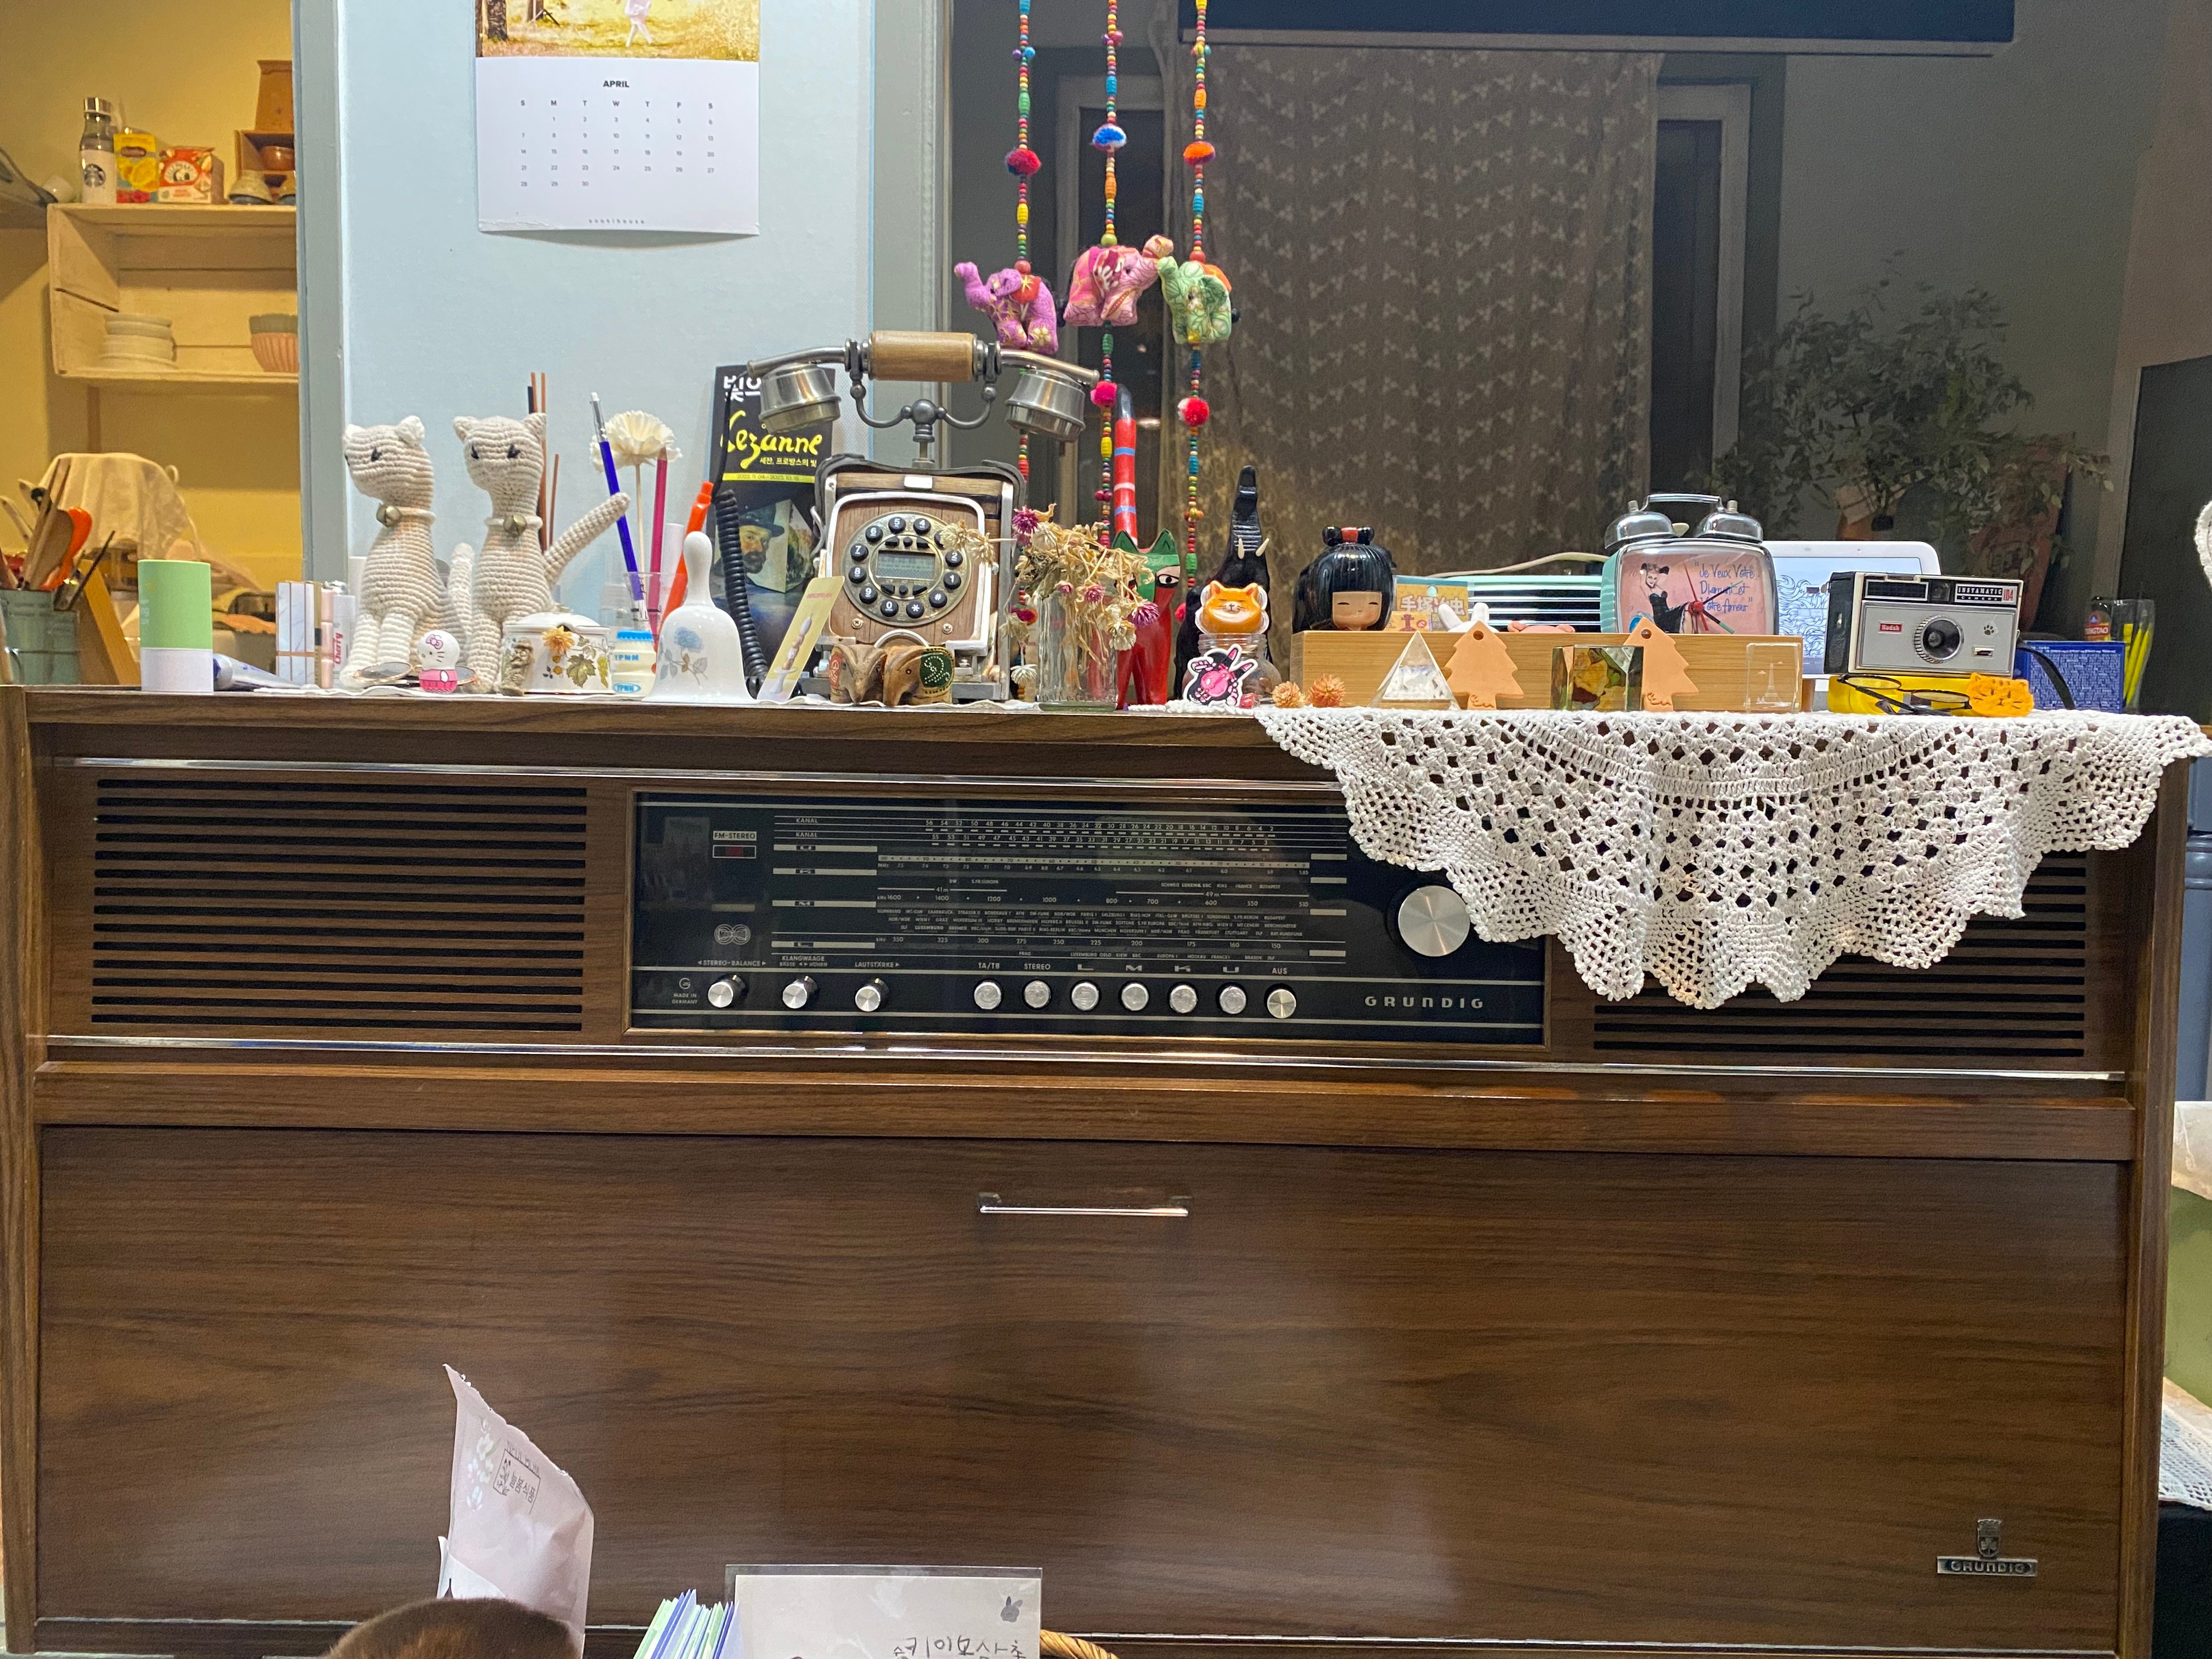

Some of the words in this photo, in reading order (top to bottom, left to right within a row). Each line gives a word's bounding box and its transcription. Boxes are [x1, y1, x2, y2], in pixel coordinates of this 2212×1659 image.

[776, 458, 809, 466] 프로방스의
[1712, 564, 1730, 578] Veux
[1734, 564, 1755, 578] Votre
[1737, 584, 1750, 595] et
[2003, 589, 2013, 601] 104
[334, 633, 343, 664] Cherry
[1365, 996, 1482, 1008] GRUNDIG
[510, 1472, 536, 1503] 늘봄식품
[1950, 1560, 2025, 1573] GRUNDIG
